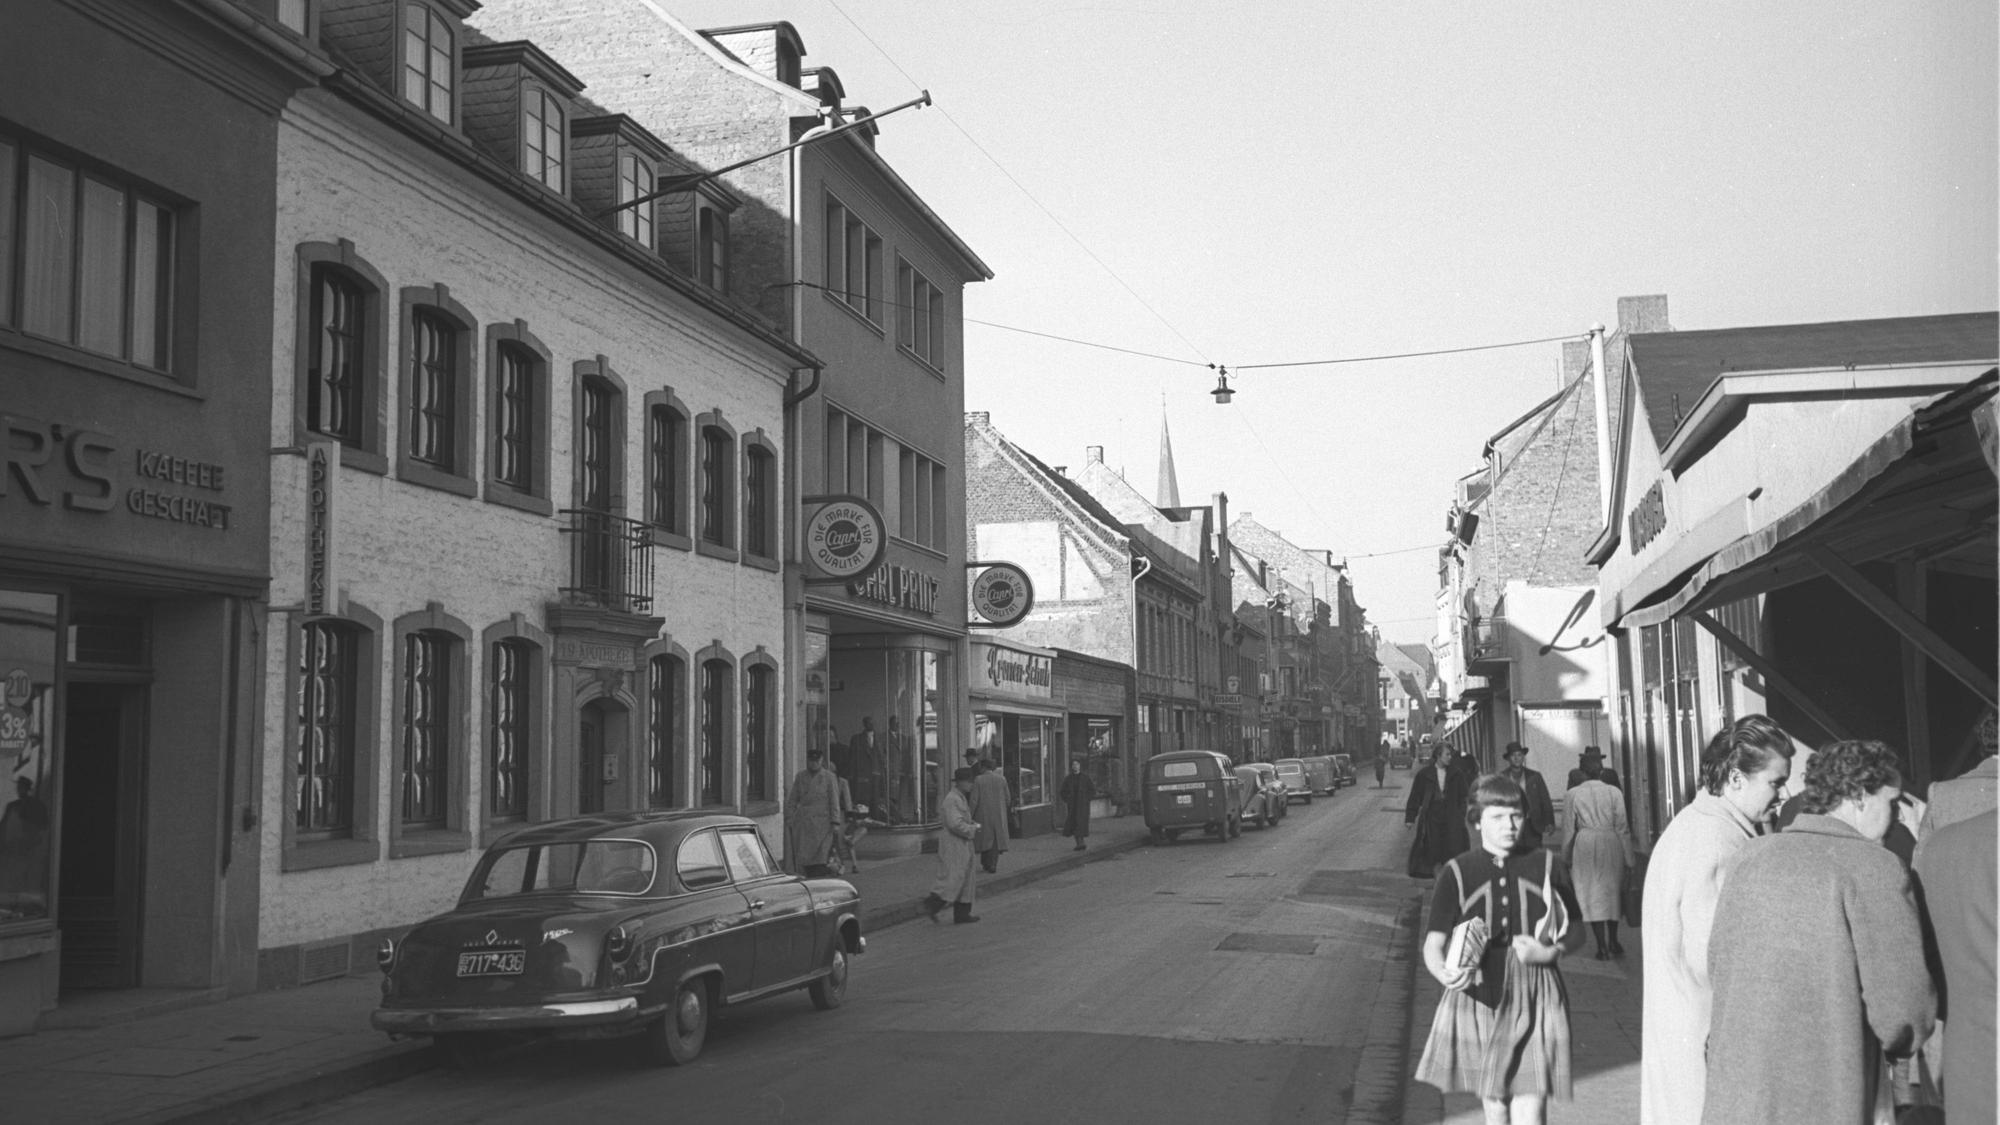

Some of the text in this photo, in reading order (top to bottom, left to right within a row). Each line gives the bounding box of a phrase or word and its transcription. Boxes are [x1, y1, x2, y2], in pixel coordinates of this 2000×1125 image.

[136, 448, 225, 491] KAFFEE
[309, 447, 327, 613] APOTHEKE
[814, 523, 827, 542] DIE
[1, 713, 27, 739] 3%
